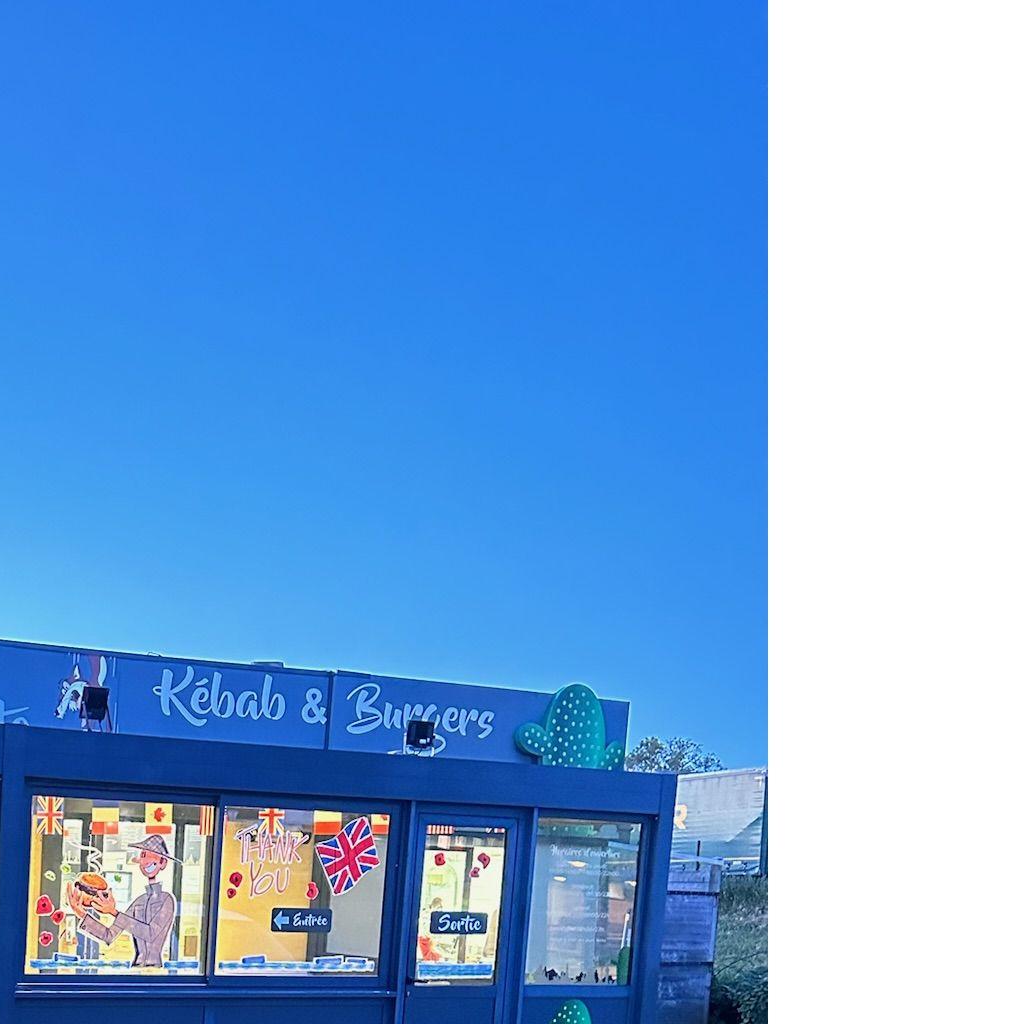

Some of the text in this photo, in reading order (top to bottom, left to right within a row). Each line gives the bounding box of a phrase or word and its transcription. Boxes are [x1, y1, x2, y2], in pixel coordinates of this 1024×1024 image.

[152, 665, 287, 727] Kébab
[301, 686, 328, 725] &
[236, 823, 310, 865] THANK
[249, 861, 291, 899] YOU
[292, 911, 329, 927] Entrée
[437, 913, 482, 932] Sortie
